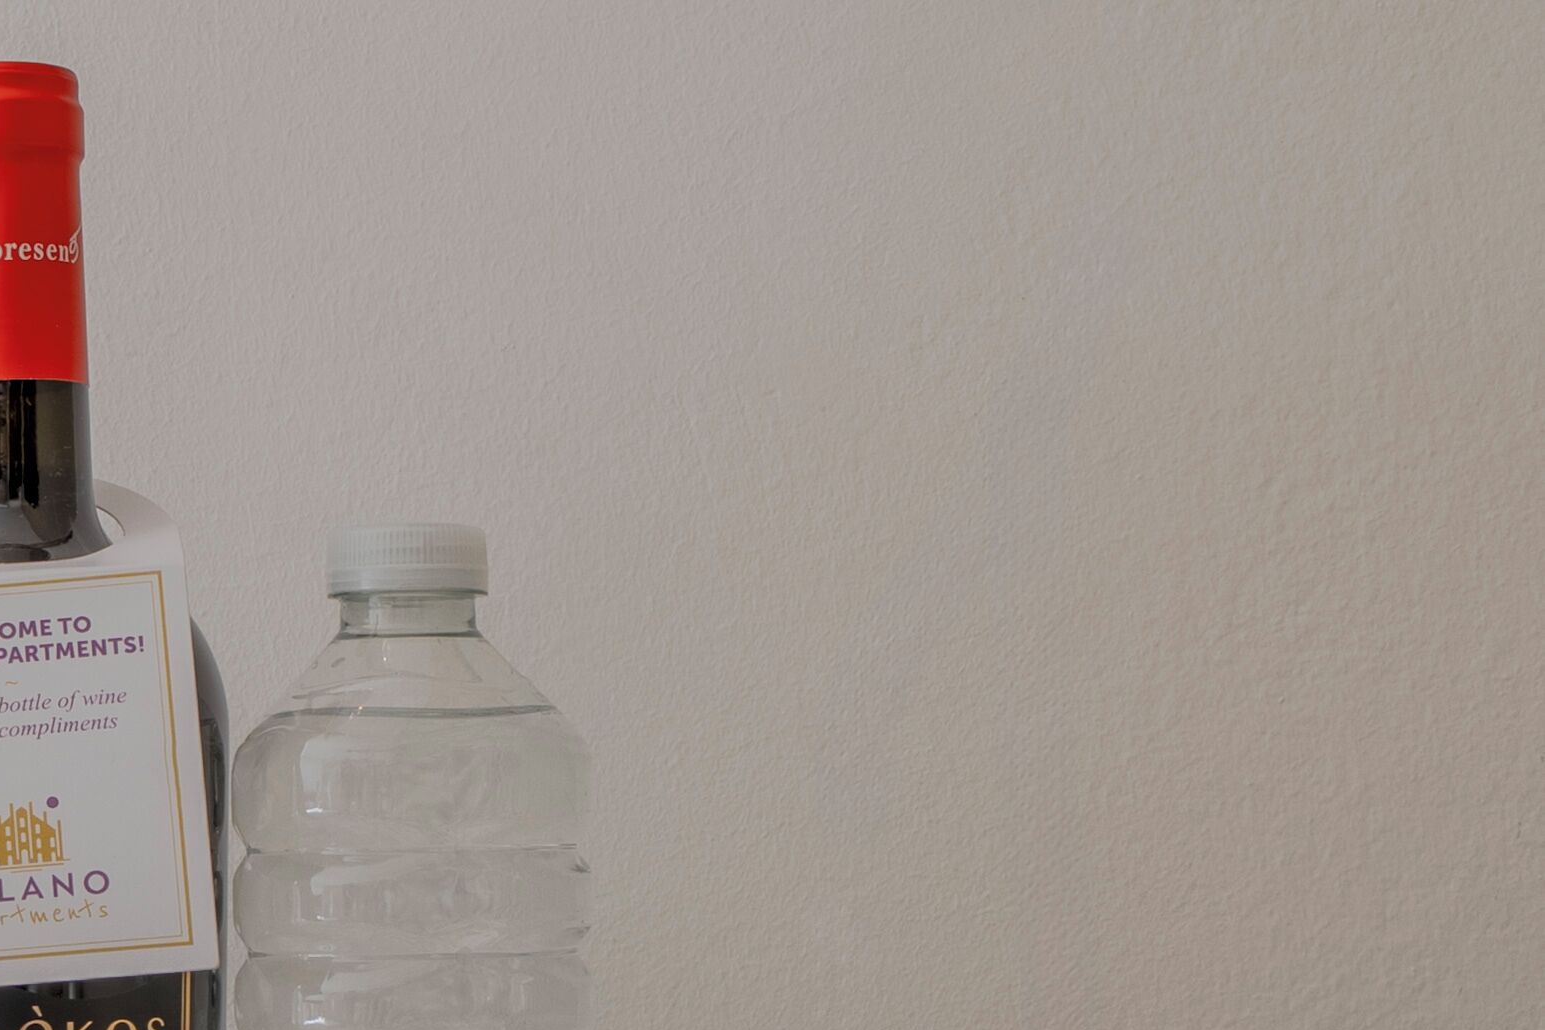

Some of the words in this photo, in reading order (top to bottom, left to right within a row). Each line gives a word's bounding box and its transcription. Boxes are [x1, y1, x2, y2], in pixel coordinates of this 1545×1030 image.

[57, 615, 92, 636] TO
[57, 690, 80, 711] of
[83, 690, 127, 706] wine
